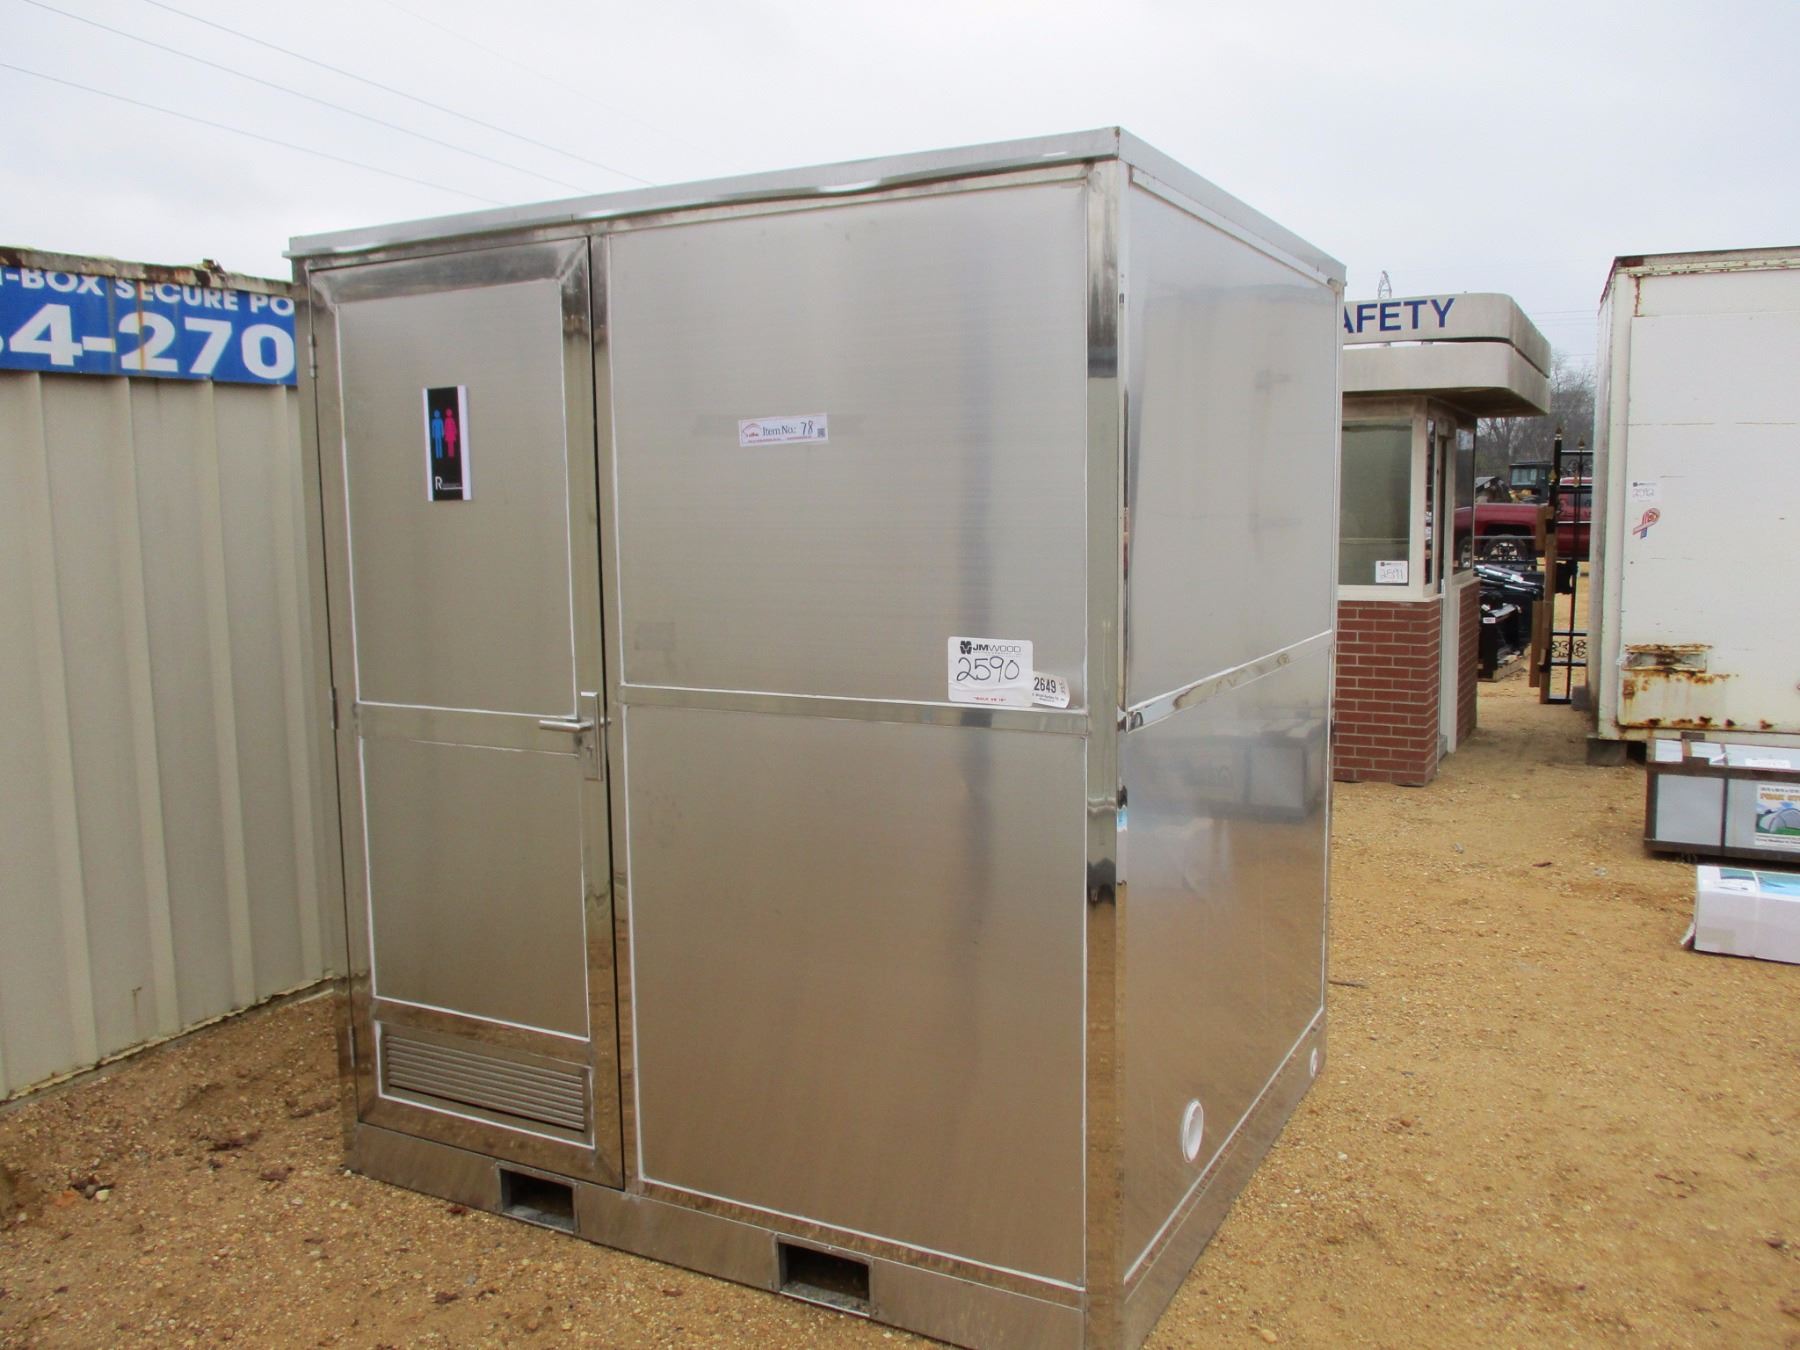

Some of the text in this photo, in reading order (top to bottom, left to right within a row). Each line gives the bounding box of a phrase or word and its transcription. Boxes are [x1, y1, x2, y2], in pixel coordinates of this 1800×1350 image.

[115, 279, 239, 311] SECURE
[762, 426, 780, 436] Item
[800, 420, 814, 435] 78
[956, 655, 1020, 682] 2590
[1033, 676, 1057, 694] 2649
